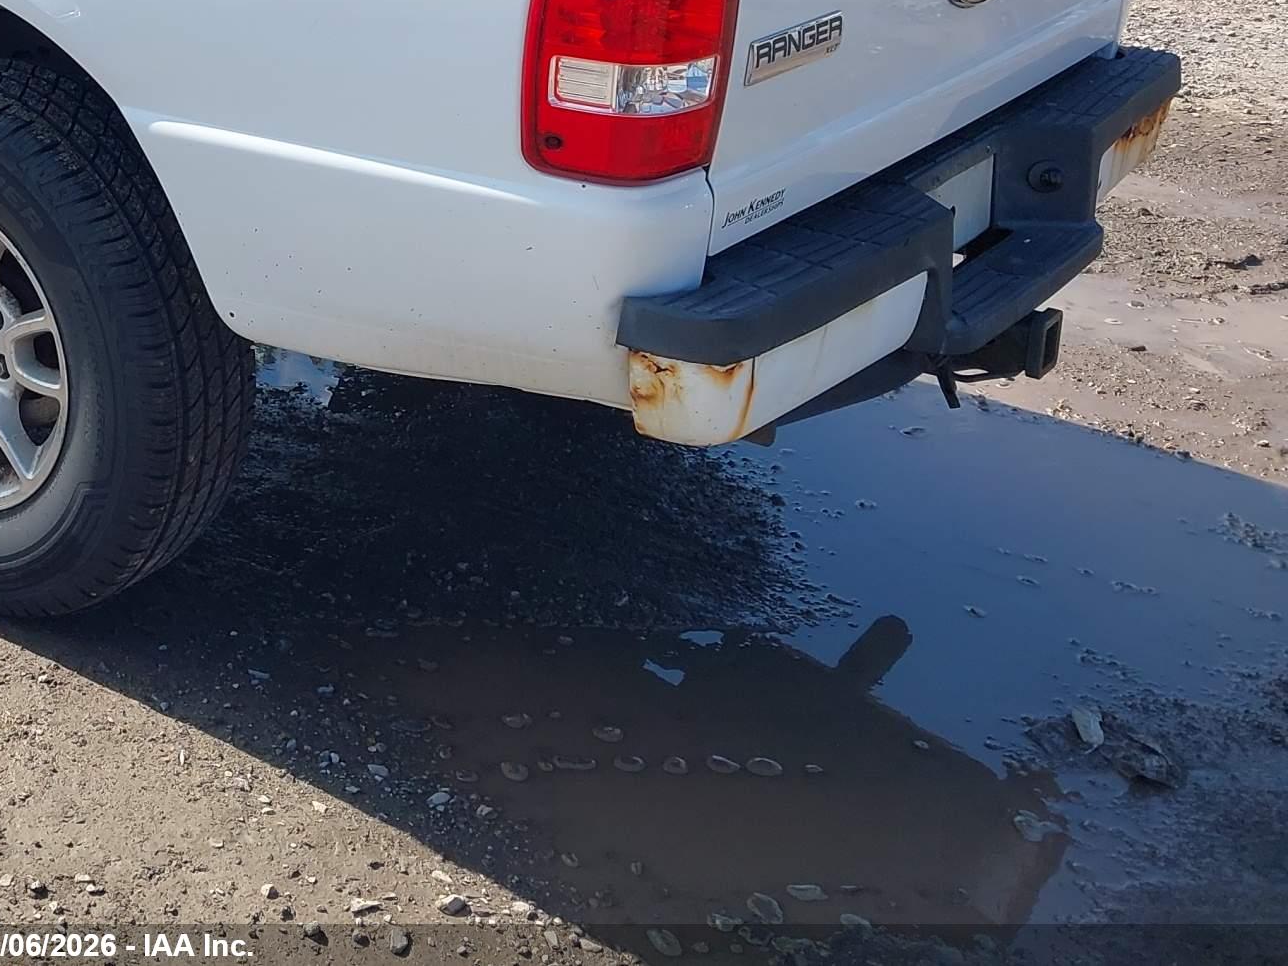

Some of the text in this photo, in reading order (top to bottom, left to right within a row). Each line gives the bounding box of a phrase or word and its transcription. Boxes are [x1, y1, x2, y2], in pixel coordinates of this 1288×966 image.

[755, 15, 843, 69] RANGER
[721, 188, 786, 229] JOHN KENNEDY
